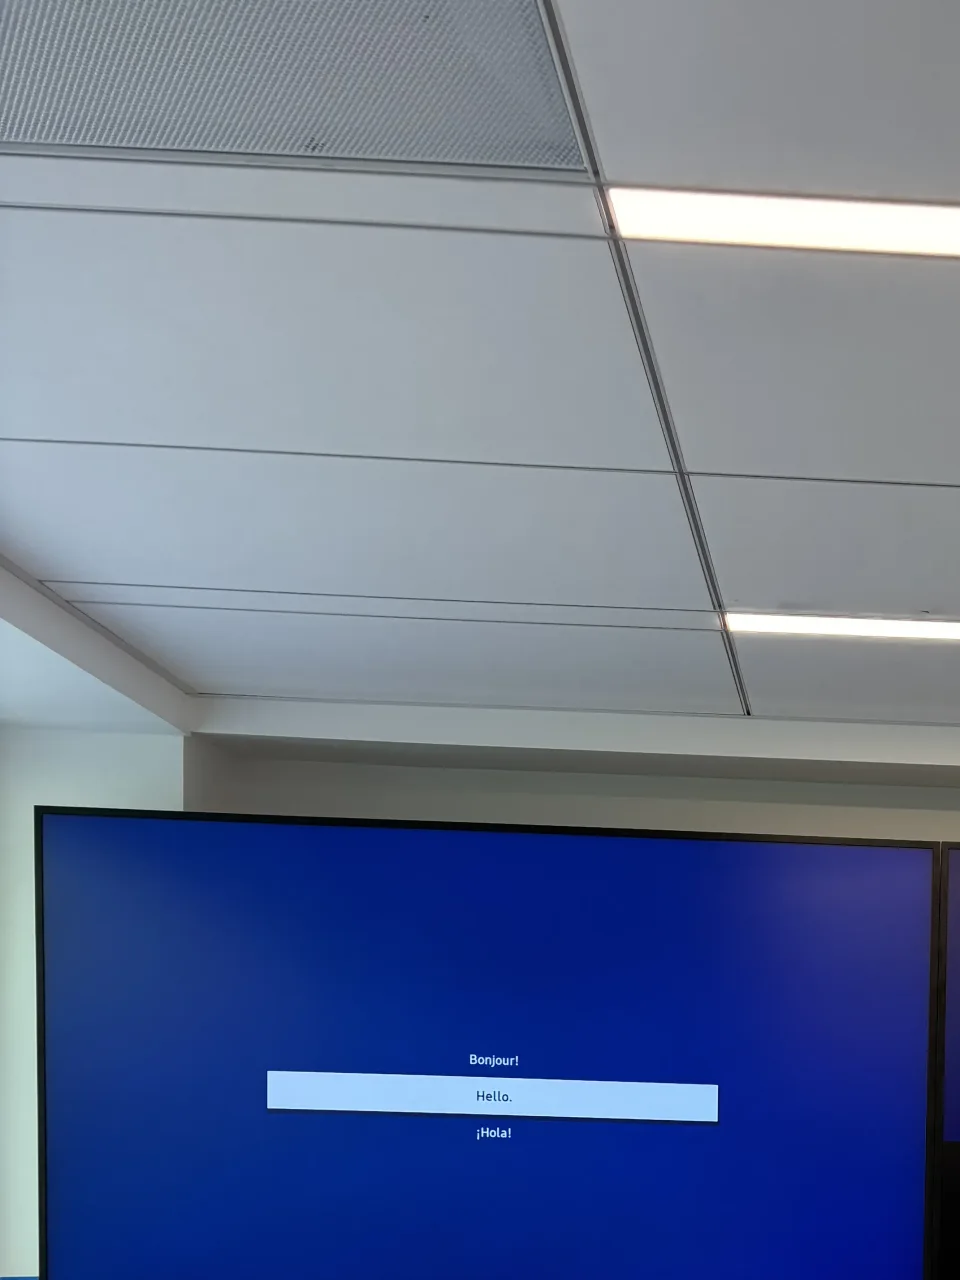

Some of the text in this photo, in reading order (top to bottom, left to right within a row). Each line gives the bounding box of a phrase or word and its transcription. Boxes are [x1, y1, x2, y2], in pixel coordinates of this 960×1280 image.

[469, 1053, 519, 1068] Bonjour!
[476, 1090, 513, 1102] Hello.
[476, 1127, 512, 1141] ¡Hola!
